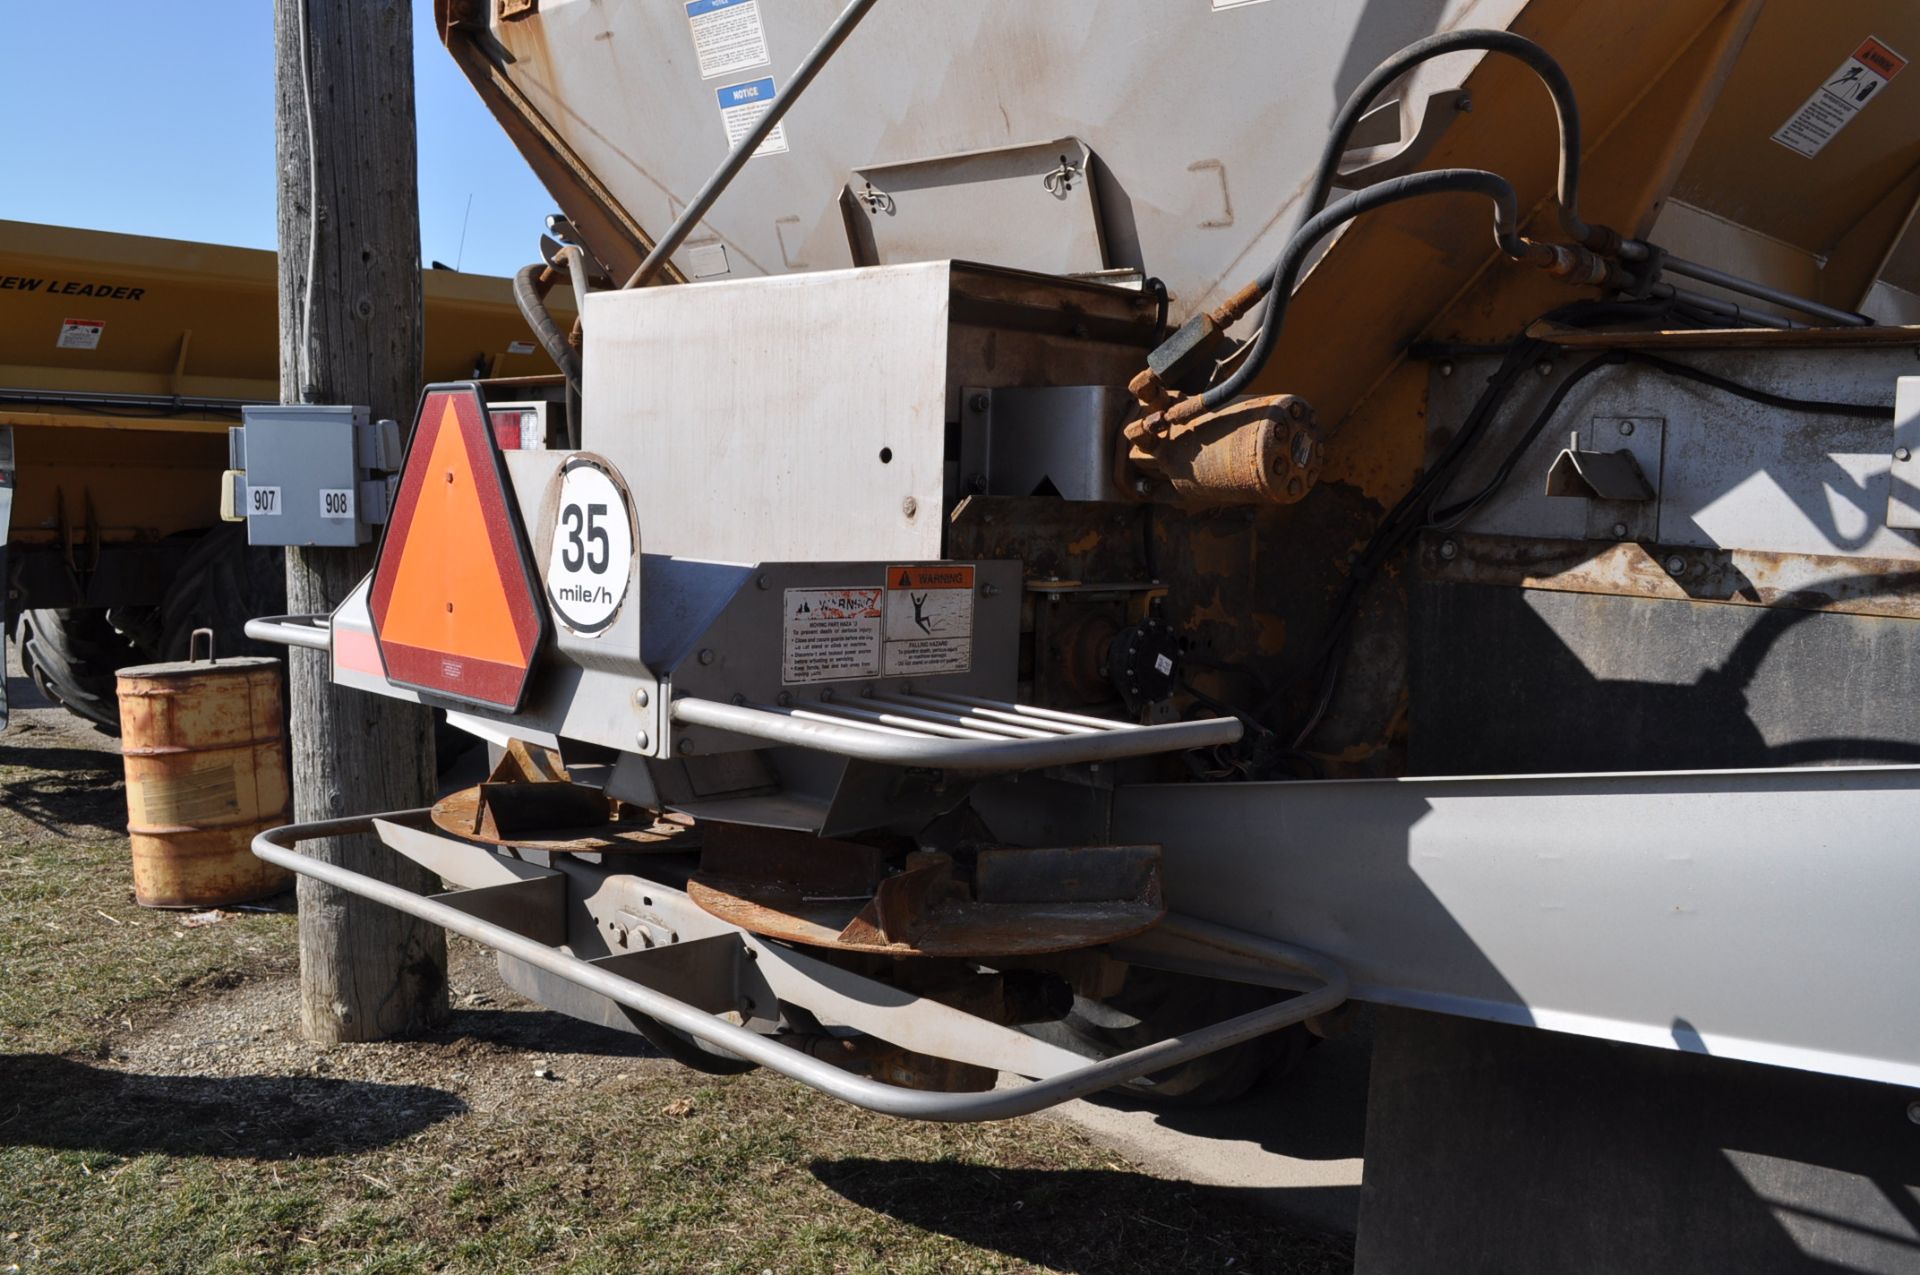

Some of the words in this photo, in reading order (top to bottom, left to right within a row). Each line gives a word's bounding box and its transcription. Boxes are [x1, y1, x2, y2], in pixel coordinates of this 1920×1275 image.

[732, 86, 759, 100] NOTICE
[0, 276, 42, 291] EW
[47, 281, 145, 300] LEADER
[254, 490, 275, 510] 907
[326, 493, 347, 513] 908
[562, 503, 610, 574] 35
[920, 573, 962, 584] WARNING
[560, 584, 612, 604] mile/h
